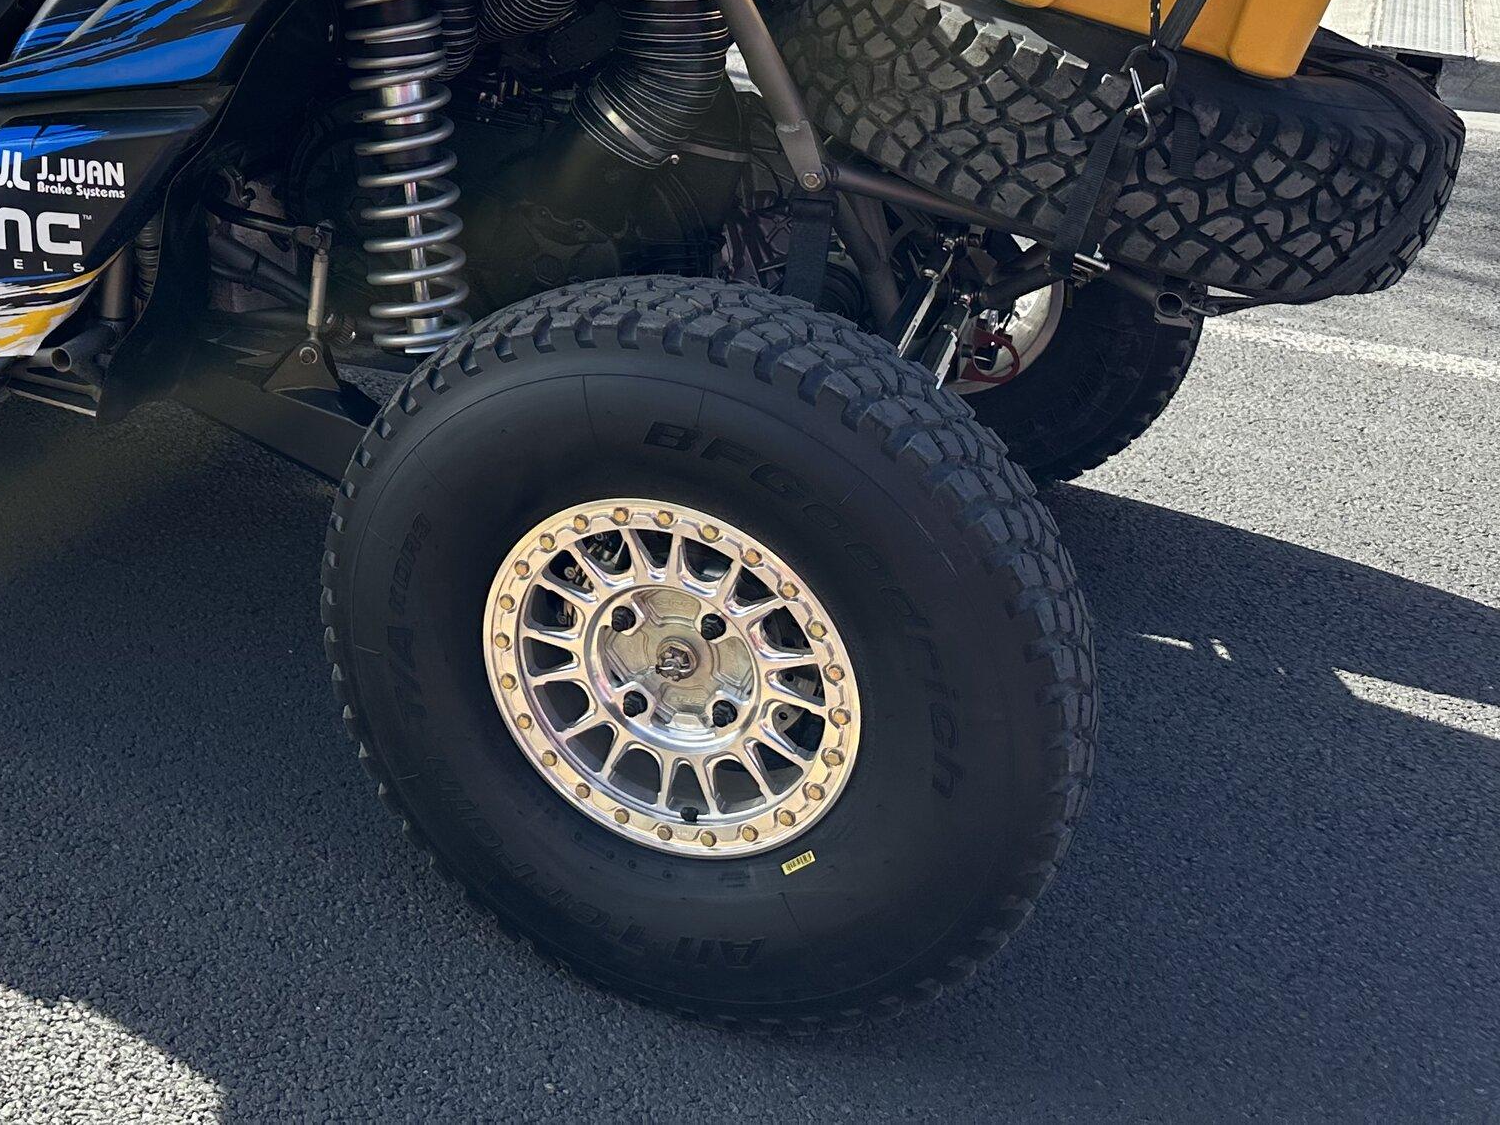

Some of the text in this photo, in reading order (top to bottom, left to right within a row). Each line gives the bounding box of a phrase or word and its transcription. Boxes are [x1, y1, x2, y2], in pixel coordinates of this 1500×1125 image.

[37, 156, 125, 187] J.JUAN
[37, 181, 126, 200] Brake Systems
